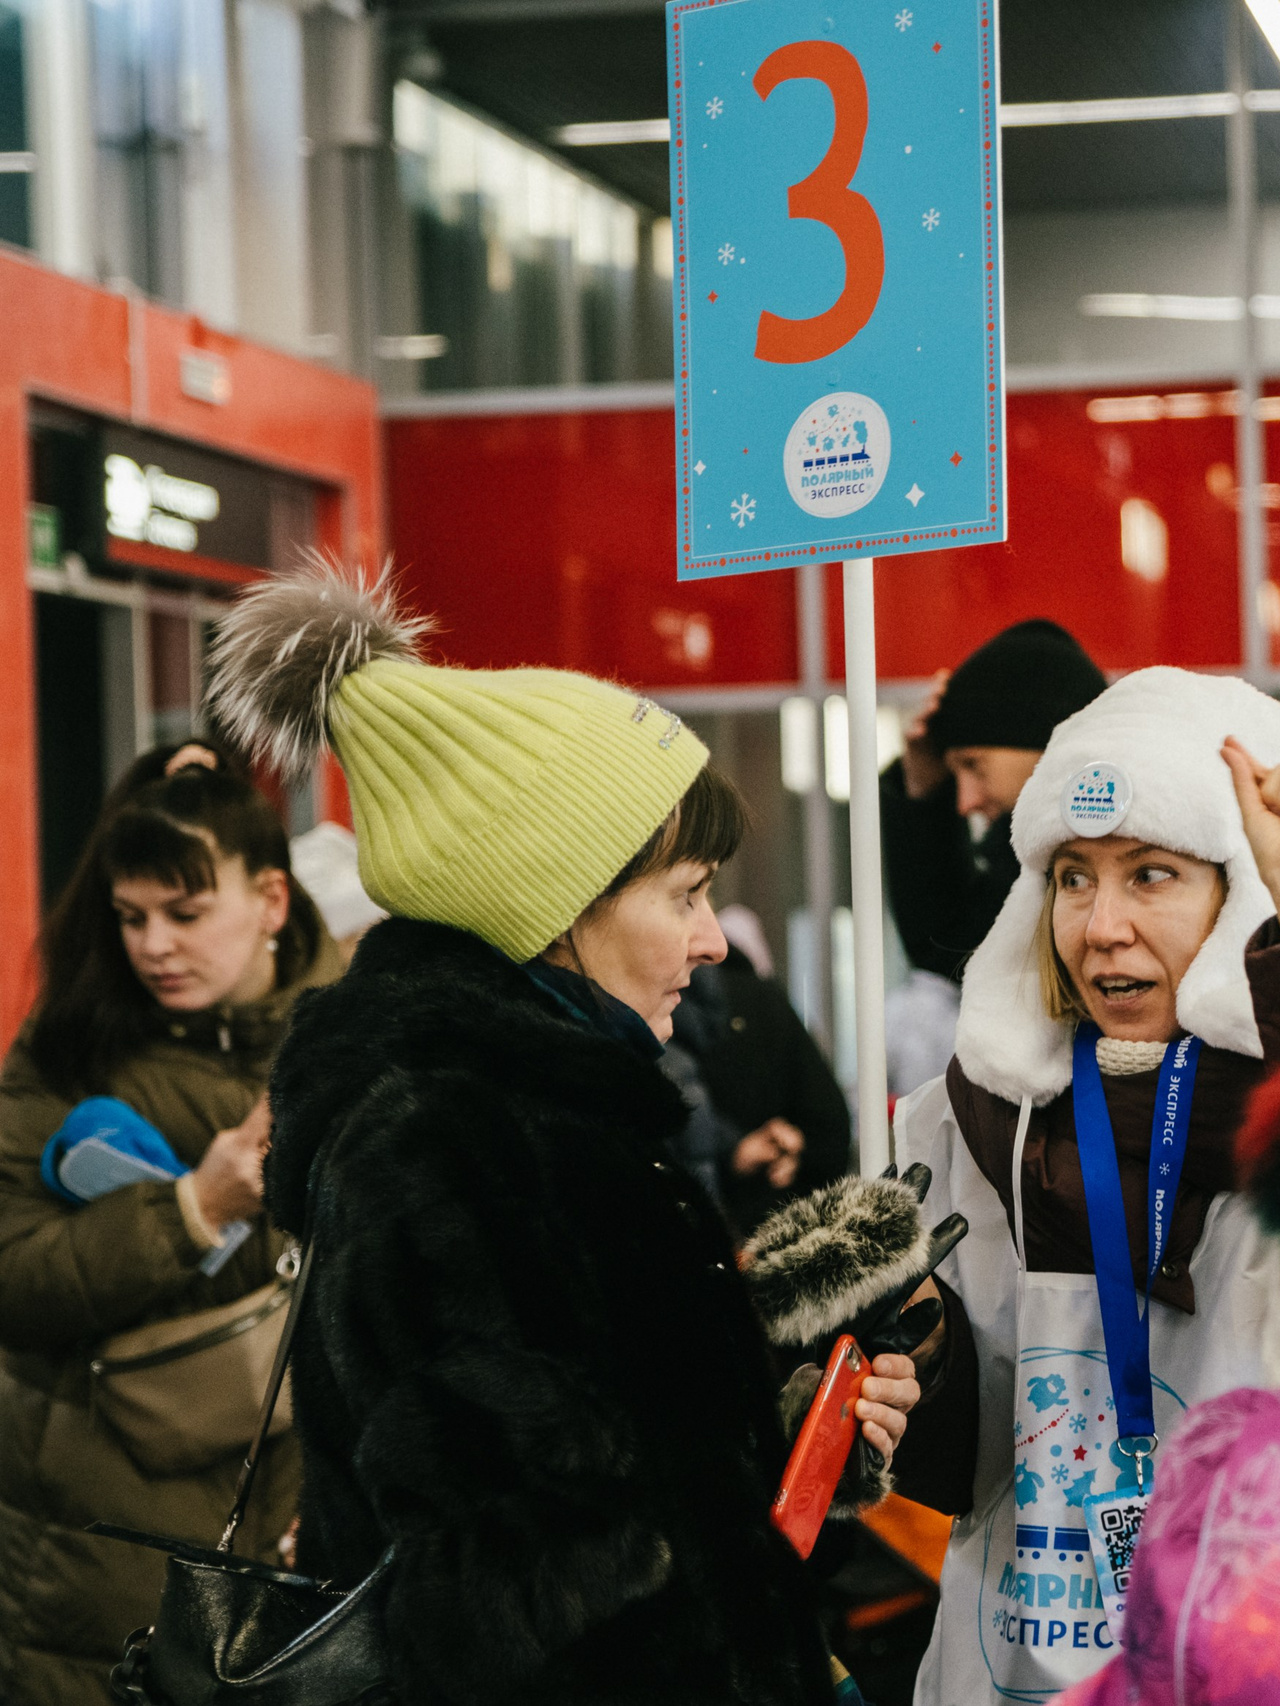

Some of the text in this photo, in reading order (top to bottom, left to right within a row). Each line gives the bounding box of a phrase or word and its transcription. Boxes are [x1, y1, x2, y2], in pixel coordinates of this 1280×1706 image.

[752, 40, 885, 364] 3
[801, 463, 875, 488] ПОЛЯРНЫЙ
[811, 483, 866, 500] ЭКСПРЕСС
[1071, 805, 1115, 813] ПОЛЯРНЫЙ
[1162, 1075, 1181, 1146] ЭКСПРЕСС
